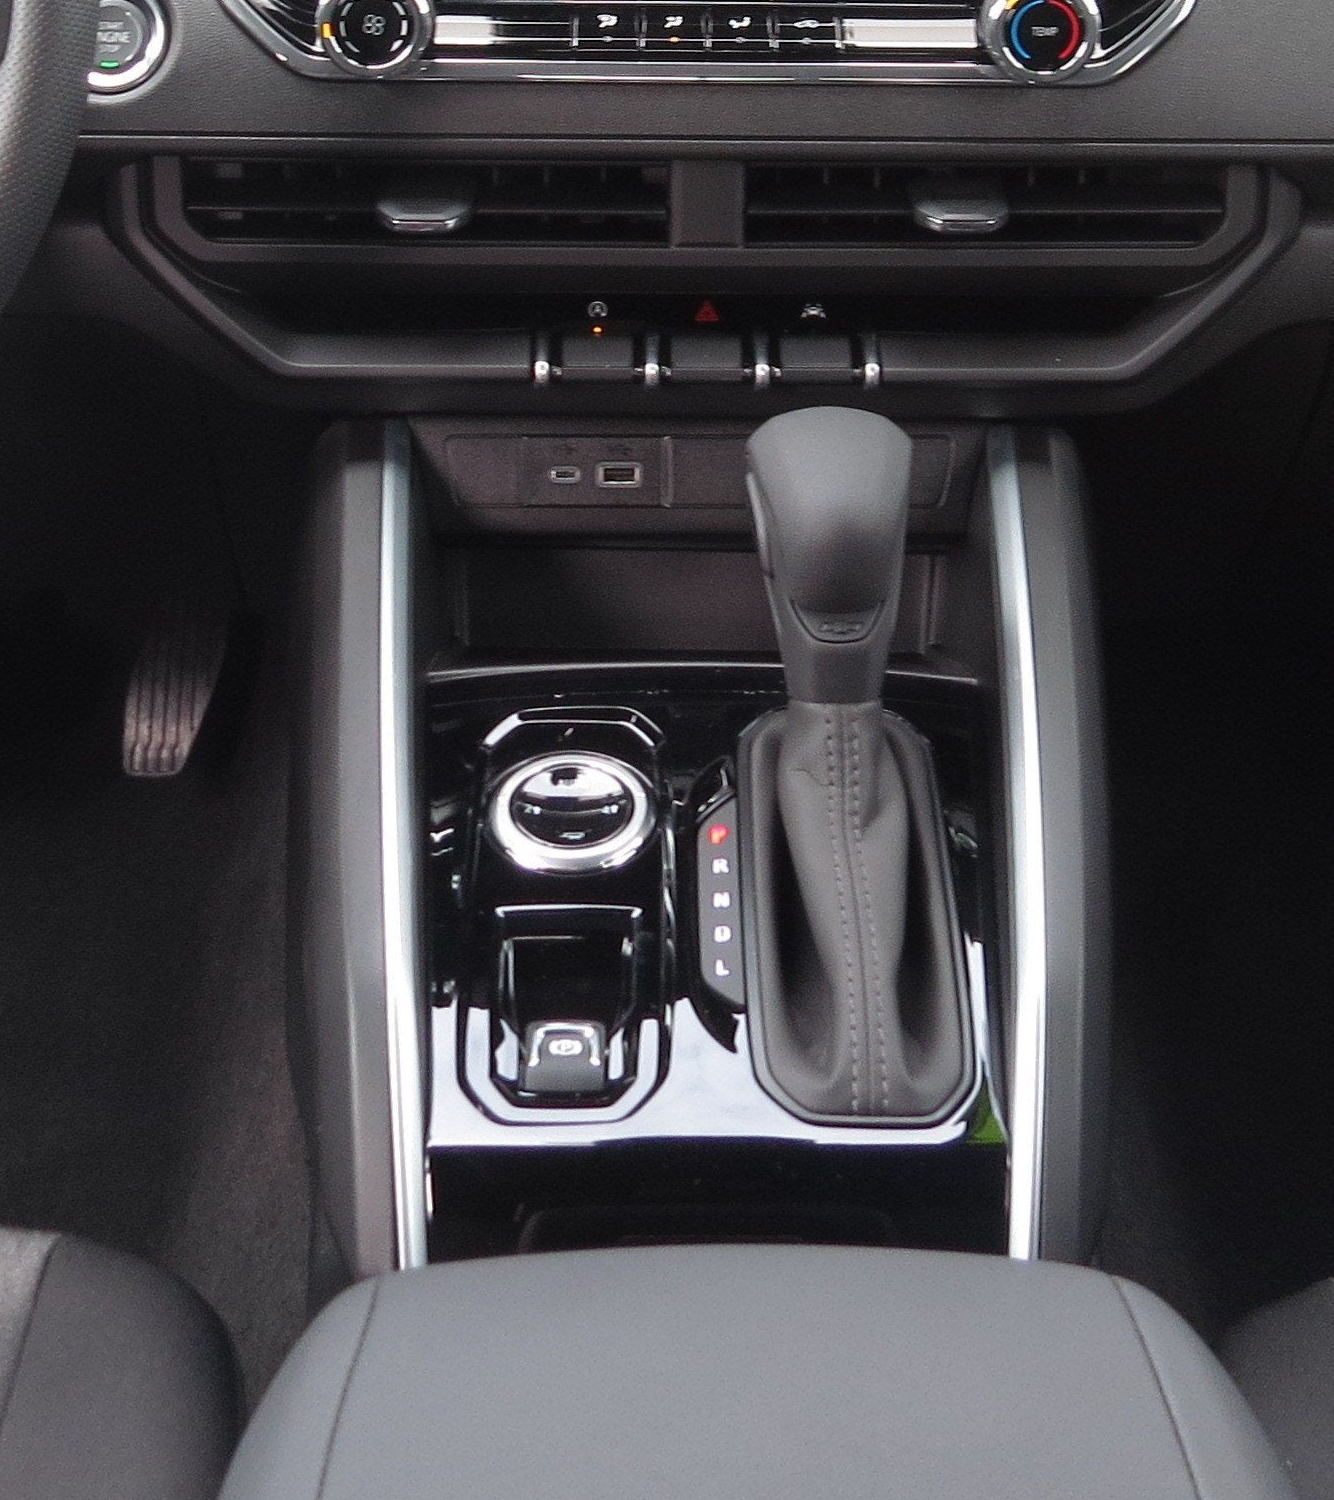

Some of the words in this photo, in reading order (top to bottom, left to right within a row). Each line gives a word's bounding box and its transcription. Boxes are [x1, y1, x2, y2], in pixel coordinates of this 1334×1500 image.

[710, 826, 729, 844] P
[712, 859, 729, 874] R
[713, 892, 730, 908] N
[714, 926, 731, 942] D
[715, 959, 730, 976] L
